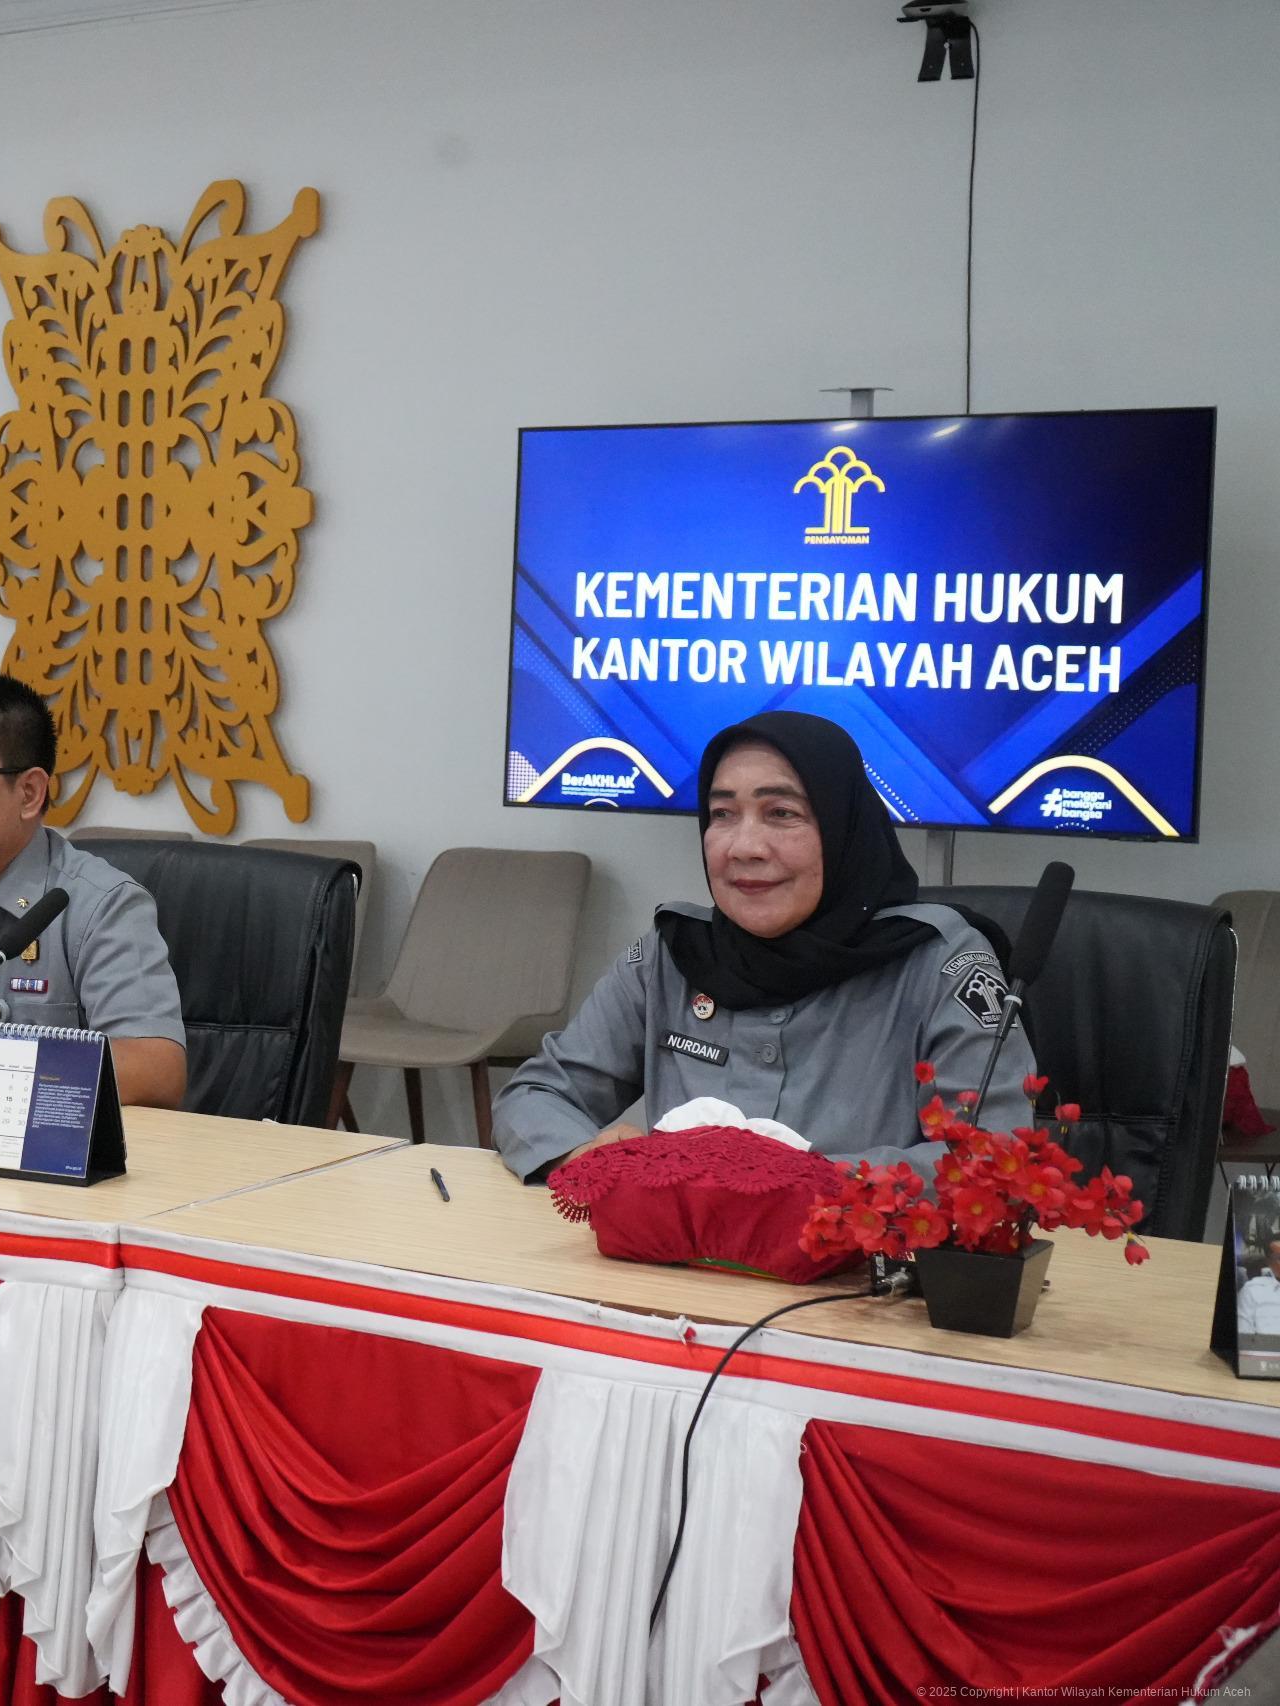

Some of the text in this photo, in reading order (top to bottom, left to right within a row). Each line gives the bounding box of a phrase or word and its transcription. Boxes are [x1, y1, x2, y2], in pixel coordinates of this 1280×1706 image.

[804, 535, 869, 544] PENGAYOMAN
[575, 571, 1124, 624] KEMENTERIAN HUKUM
[572, 637, 1121, 693] KANTOR WILAYAH ACEH
[561, 768, 639, 788] BerAKHLAK
[1062, 789, 1104, 801] bangga
[1062, 799, 1112, 810] melayani
[1062, 808, 1103, 821] bangsa
[667, 1034, 721, 1060] NURDANI
